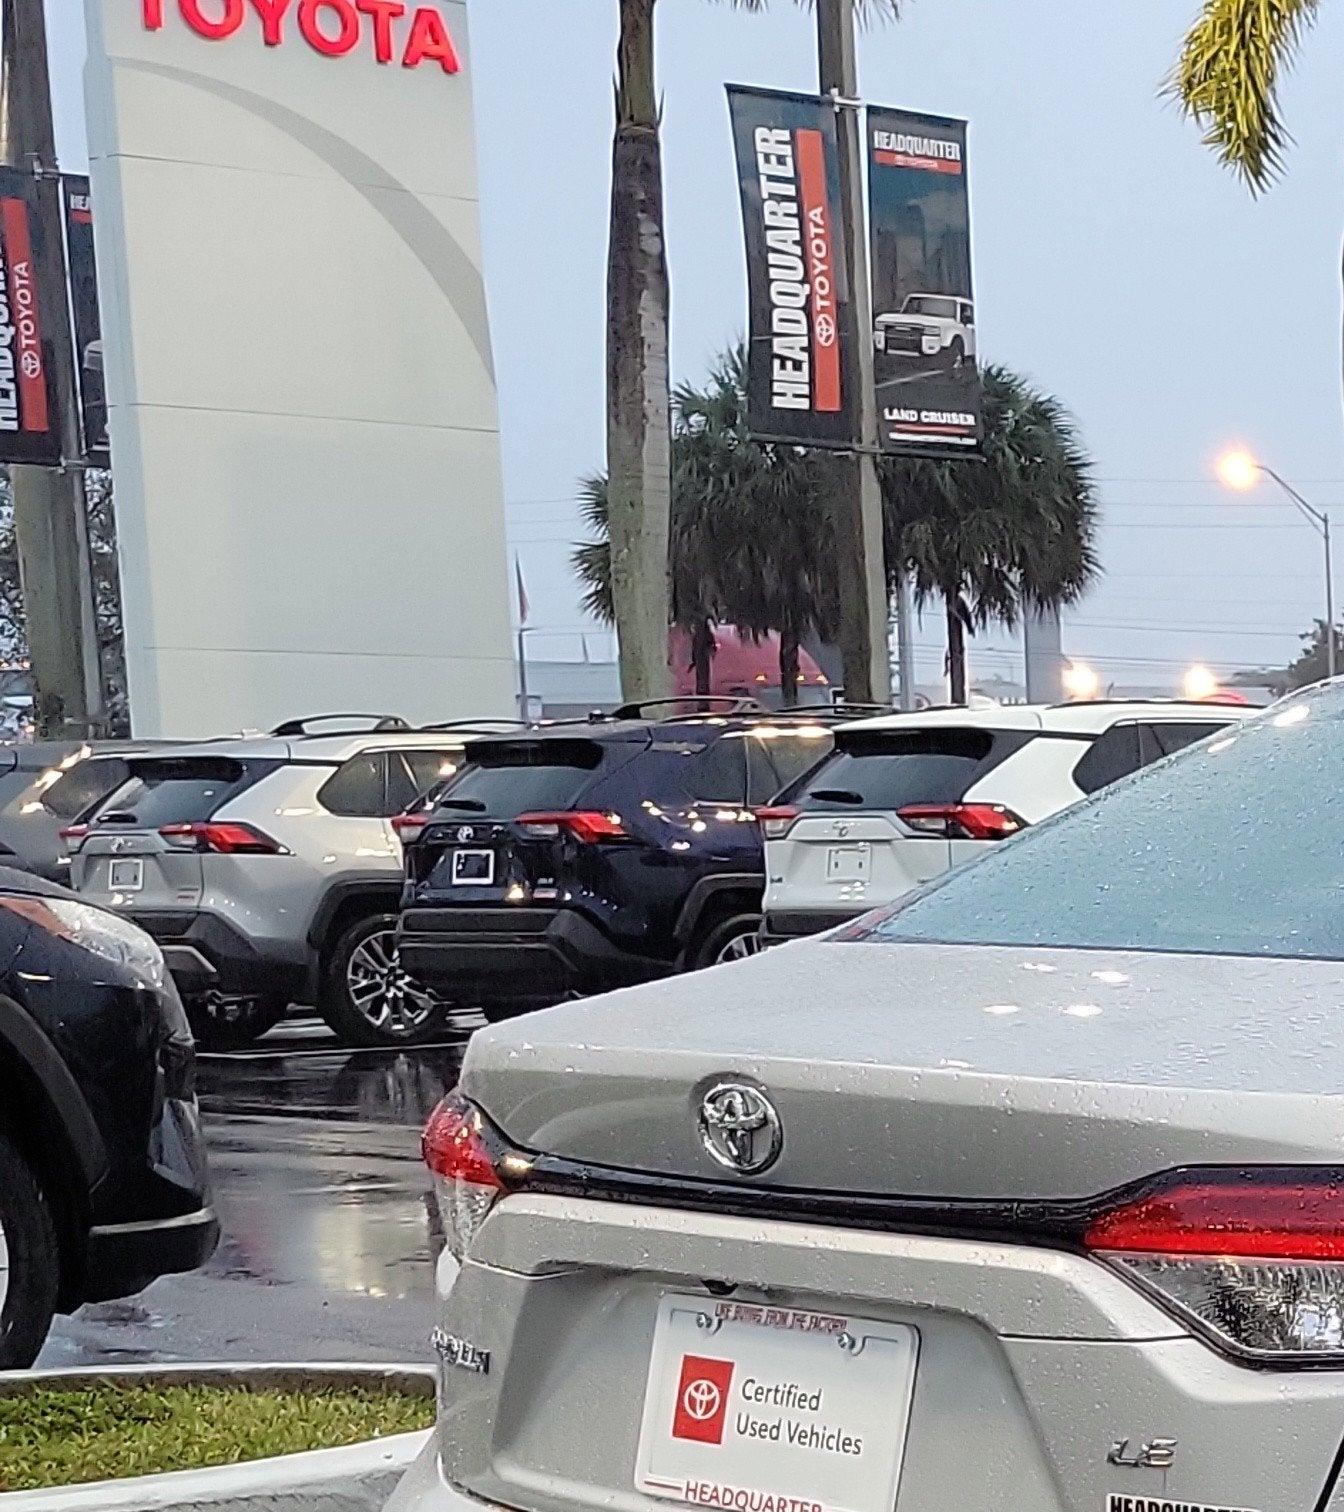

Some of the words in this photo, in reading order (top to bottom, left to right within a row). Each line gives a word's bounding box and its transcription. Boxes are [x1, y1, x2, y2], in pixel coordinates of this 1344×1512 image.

[874, 130, 960, 161] HEADQUARTER
[754, 126, 811, 411] HEADQUARTER
[808, 206, 830, 311] TOYOTA
[13, 261, 35, 348] TOYOTA
[883, 407, 918, 421] LAND
[742, 1379, 822, 1411] Certified
[736, 1413, 781, 1441] Used
[787, 1419, 863, 1455] Vehicles
[1107, 1437, 1178, 1467] LE
